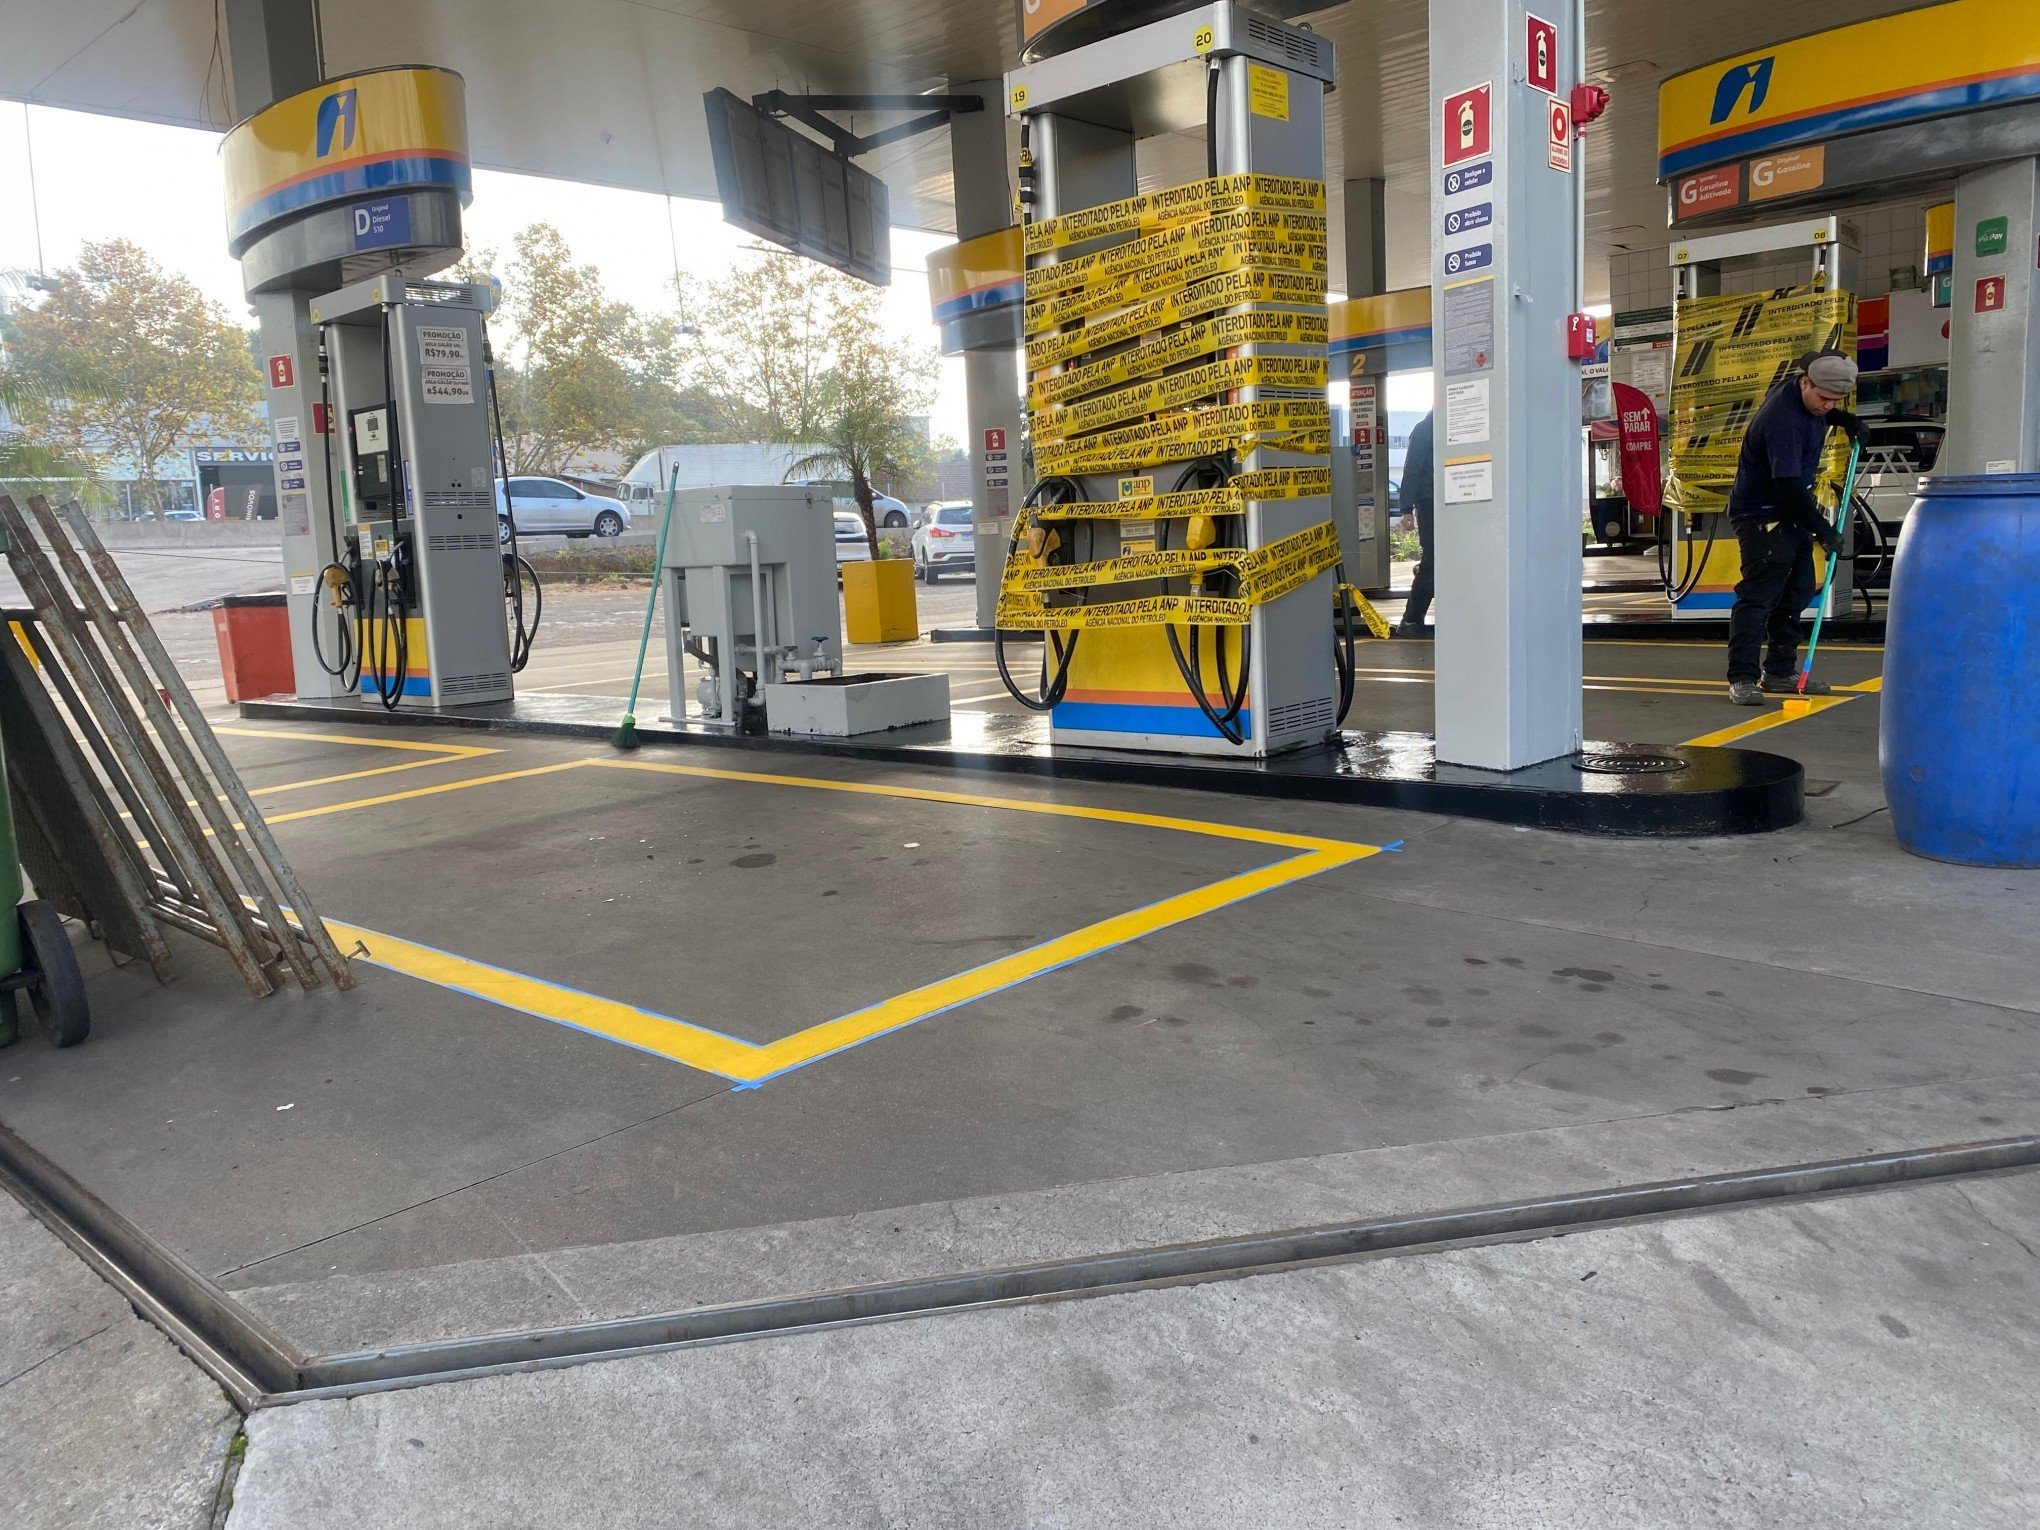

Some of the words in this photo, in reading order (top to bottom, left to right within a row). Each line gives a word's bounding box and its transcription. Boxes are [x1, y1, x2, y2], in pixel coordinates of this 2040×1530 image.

[1196, 31, 1212, 46] 20
[1014, 90, 1026, 103] 19
[1777, 154, 1800, 164] Original
[1753, 161, 1774, 187] G
[1777, 162, 1812, 174] Gasolina
[1681, 179, 1697, 205] G
[1699, 180, 1729, 193] Gasolina
[1699, 188, 1732, 202] Aditivada
[371, 204, 389, 212] Original
[1044, 220, 1058, 235] ANP
[1062, 207, 1109, 231] INTERDITADO
[1110, 202, 1130, 222] PELA
[1131, 198, 1147, 214] ANP
[1152, 184, 1203, 211] INTERDITADO
[1205, 179, 1231, 198] PELA
[1232, 175, 1250, 192] ANP
[1255, 177, 1291, 195] INTERDITADO
[372, 214, 391, 223] Diesel
[1117, 217, 1140, 231] PETRÓLEO
[1179, 203, 1203, 215] NACIONAL
[1203, 200, 1211, 210] DO
[1211, 195, 1244, 208] PETRÓLEO
[355, 208, 370, 236] D
[373, 225, 384, 234] S10
[1081, 256, 1096, 270] ANP
[1100, 241, 1146, 266] INTERDITADO
[1148, 234, 1169, 252] PELA
[1170, 226, 1186, 244] ANP
[1191, 212, 1250, 239] INTERDITADO
[1814, 232, 1826, 240] 08
[1978, 232, 2004, 243] PicPay
[1066, 273, 1088, 287] PETRÓLEO
[1154, 246, 1179, 261] PETRÓLEO
[1220, 231, 1250, 246] NACIONAL
[1677, 252, 1688, 260] 07
[1100, 292, 1124, 308] PETRÓLEO
[1191, 262, 1218, 278] PETRÓLEO
[1150, 298, 1166, 313] ANP
[1170, 279, 1224, 308] INTERDITADO
[1226, 272, 1251, 292] PELA
[1268, 273, 1305, 291] INTERDITADO
[1031, 304, 1046, 320] ANP
[1050, 290, 1093, 314] INTERDITADO
[1137, 315, 1162, 331] PETRÓLEO
[1199, 297, 1223, 311] NACIONAL
[1225, 294, 1233, 304] DO
[1768, 299, 1822, 315] INTERDITADO
[423, 332, 461, 341] PROMOÇÃO
[1719, 340, 1772, 353] INTERDITADO
[1773, 336, 1793, 345] PELA
[1794, 333, 1812, 342] ANP
[425, 349, 460, 358] R$79,90
[1038, 369, 1082, 394] INTERDITADO
[1101, 358, 1116, 373] ANP
[1120, 340, 1167, 366] INTERDITADO
[1168, 333, 1190, 352] PELA
[1190, 324, 1206, 343] ANP
[1210, 312, 1266, 337] INTERDITADO
[1176, 344, 1200, 359] PETRÓLEO
[1218, 334, 1243, 347] AGÊNCIA
[1350, 353, 1366, 377] 2
[427, 370, 465, 379] PROMOÇÃO
[1722, 375, 1741, 384] PELA
[1743, 372, 1759, 380] ANP
[427, 386, 463, 396] R$44,90
[1036, 413, 1054, 431] PELA
[1055, 409, 1068, 424] ANP
[1072, 396, 1116, 419] INTERDITADO
[1118, 391, 1137, 408] PELA
[1138, 384, 1153, 400] ANP
[1157, 368, 1207, 396] INTERDITADO
[1208, 364, 1231, 382] PELA
[1233, 358, 1253, 376] ANP
[1124, 403, 1148, 418] PETRÓLEO
[1623, 411, 1641, 423] SEM
[1083, 436, 1097, 450] ANP
[1102, 424, 1150, 446] INTERDITADO
[1151, 420, 1171, 436] PELA
[1172, 416, 1188, 431] ANP
[1192, 405, 1249, 429] INTERDITADO
[1252, 403, 1269, 418] PELA
[1220, 423, 1248, 436] NACIONAL
[1624, 421, 1650, 433] PARAR
[1136, 446, 1153, 459] ANP
[1156, 439, 1209, 458] INTERDITADO
[1626, 441, 1652, 452] COMPRE
[1133, 479, 1151, 491] anp
[1066, 502, 1117, 516] INTERDITADO
[1117, 500, 1136, 513] PELA
[1138, 498, 1154, 511] ANP
[1157, 492, 1209, 510] INTERDITADO
[1211, 503, 1240, 513] PETRÓLEO
[1004, 570, 1020, 581] ANP
[1022, 567, 1069, 580] INTERDITADO
[1090, 561, 1107, 572] ANP
[1110, 553, 1162, 570] INTERDITADO
[1071, 574, 1096, 585] PETRÓLEO
[1113, 571, 1135, 581] AGÊNCIA
[1135, 568, 1159, 579] NACIONAL
[1160, 566, 1168, 575] DO
[1168, 563, 1196, 575] PETRÓLEO
[1083, 603, 1134, 617] INTERDITADO
[1136, 599, 1159, 612] PELA
[1160, 597, 1179, 611] ANP
[1184, 599, 1246, 615] INTERDITADO
[1043, 618, 1067, 628] PETRÓLEO
[1085, 618, 1106, 627] AGÊNCIA
[1106, 617, 1129, 626] NACIONAL
[1139, 613, 1166, 623] PETRÓLEO
[1187, 615, 1213, 623] AGÊNCIA
[1215, 615, 1243, 623] NACIONAL
